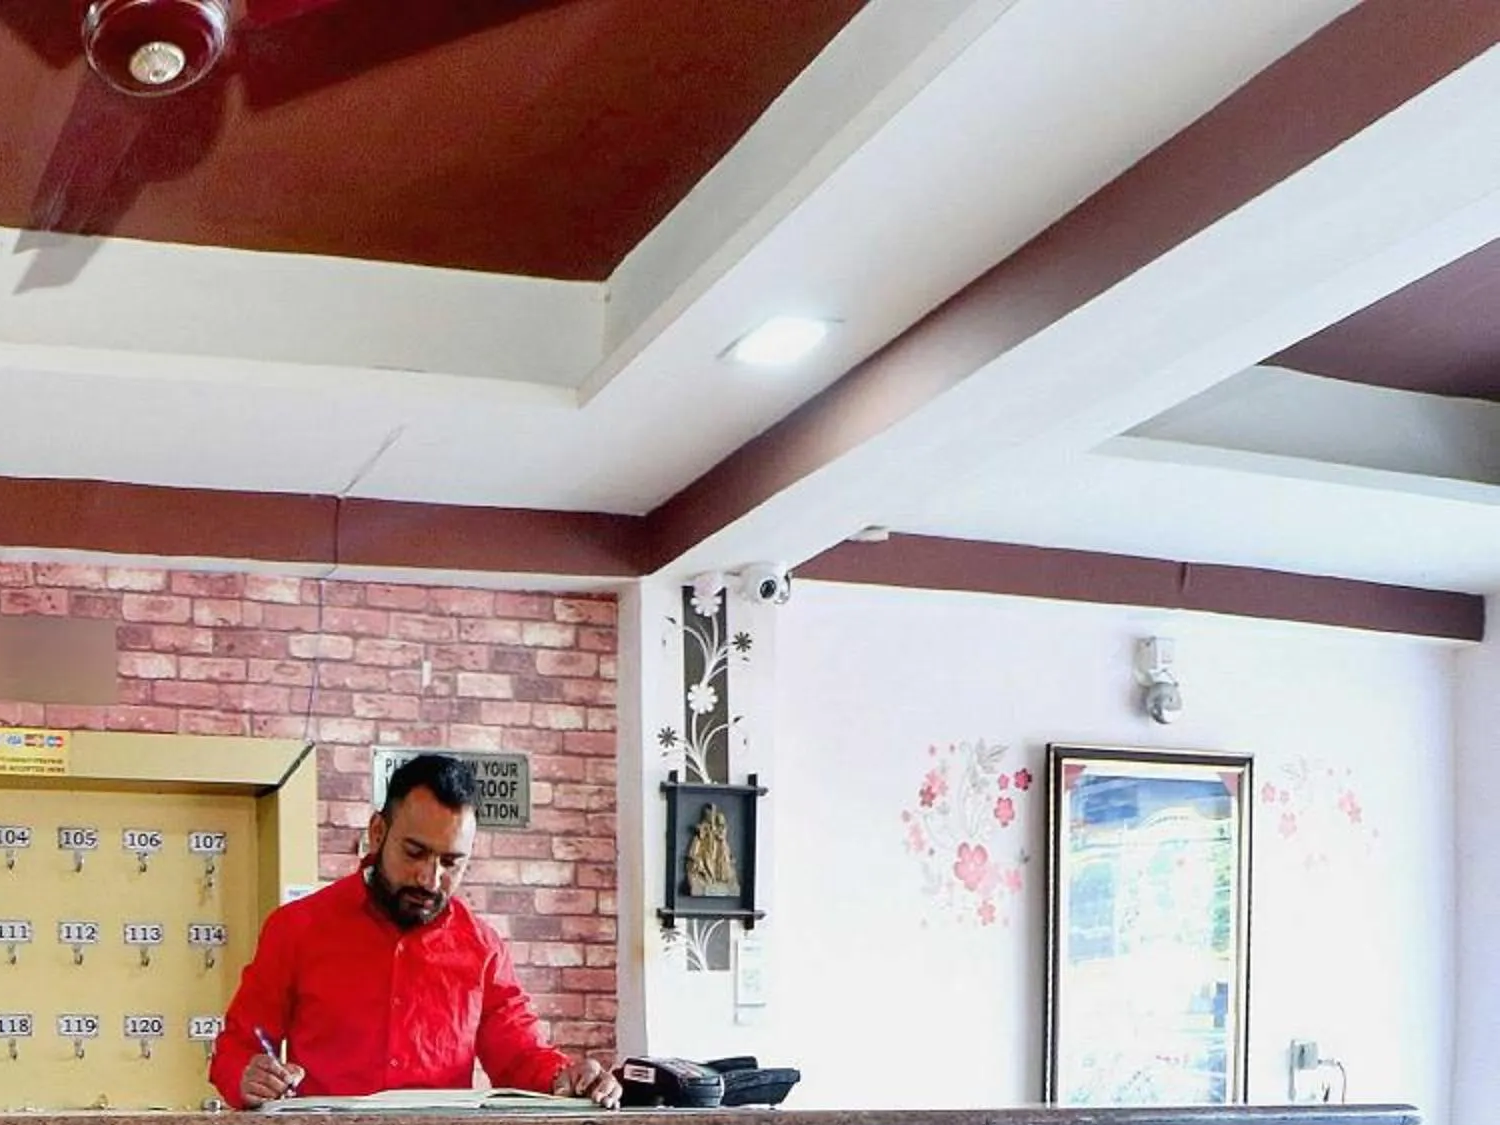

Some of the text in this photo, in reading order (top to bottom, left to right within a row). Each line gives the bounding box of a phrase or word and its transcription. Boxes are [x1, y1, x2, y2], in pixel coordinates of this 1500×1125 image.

[484, 760, 518, 778] YOUR
[63, 831, 97, 846] 105
[127, 833, 161, 847] 106
[193, 835, 224, 848] 107
[63, 926, 96, 940] 112
[129, 927, 161, 941] 113
[192, 927, 224, 941] 114
[63, 1019, 97, 1033] 119
[131, 1019, 162, 1033] 120
